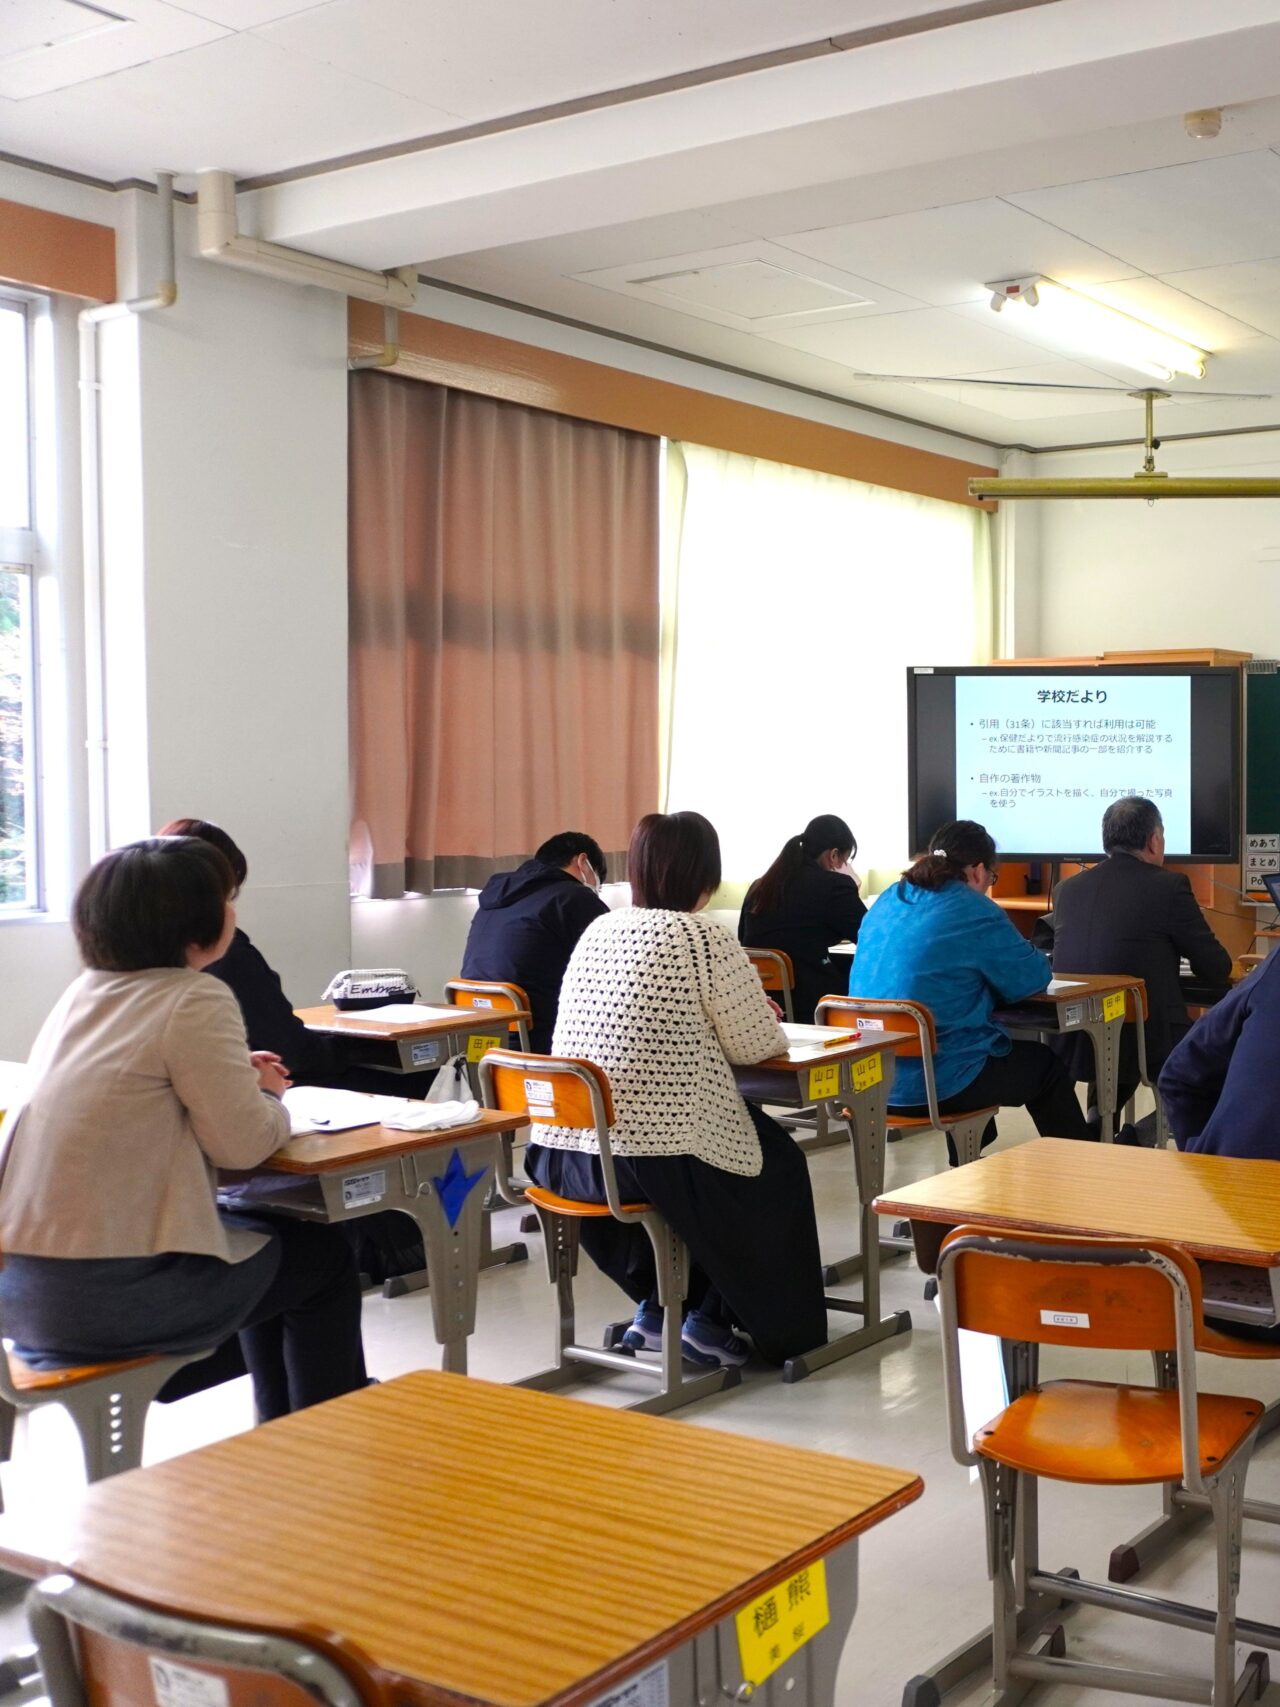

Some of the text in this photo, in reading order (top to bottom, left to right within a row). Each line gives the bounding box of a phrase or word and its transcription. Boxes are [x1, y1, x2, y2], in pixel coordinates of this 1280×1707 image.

[1036, 689, 1108, 704] 学校だより
[978, 773, 1042, 784] 自作の著作物
[989, 799, 1017, 808] を使う
[1249, 839, 1277, 848] めあて
[1249, 858, 1277, 867] まとめ
[1250, 876, 1264, 886] Po
[857, 1058, 877, 1076] 山口
[814, 1068, 834, 1083] 山口
